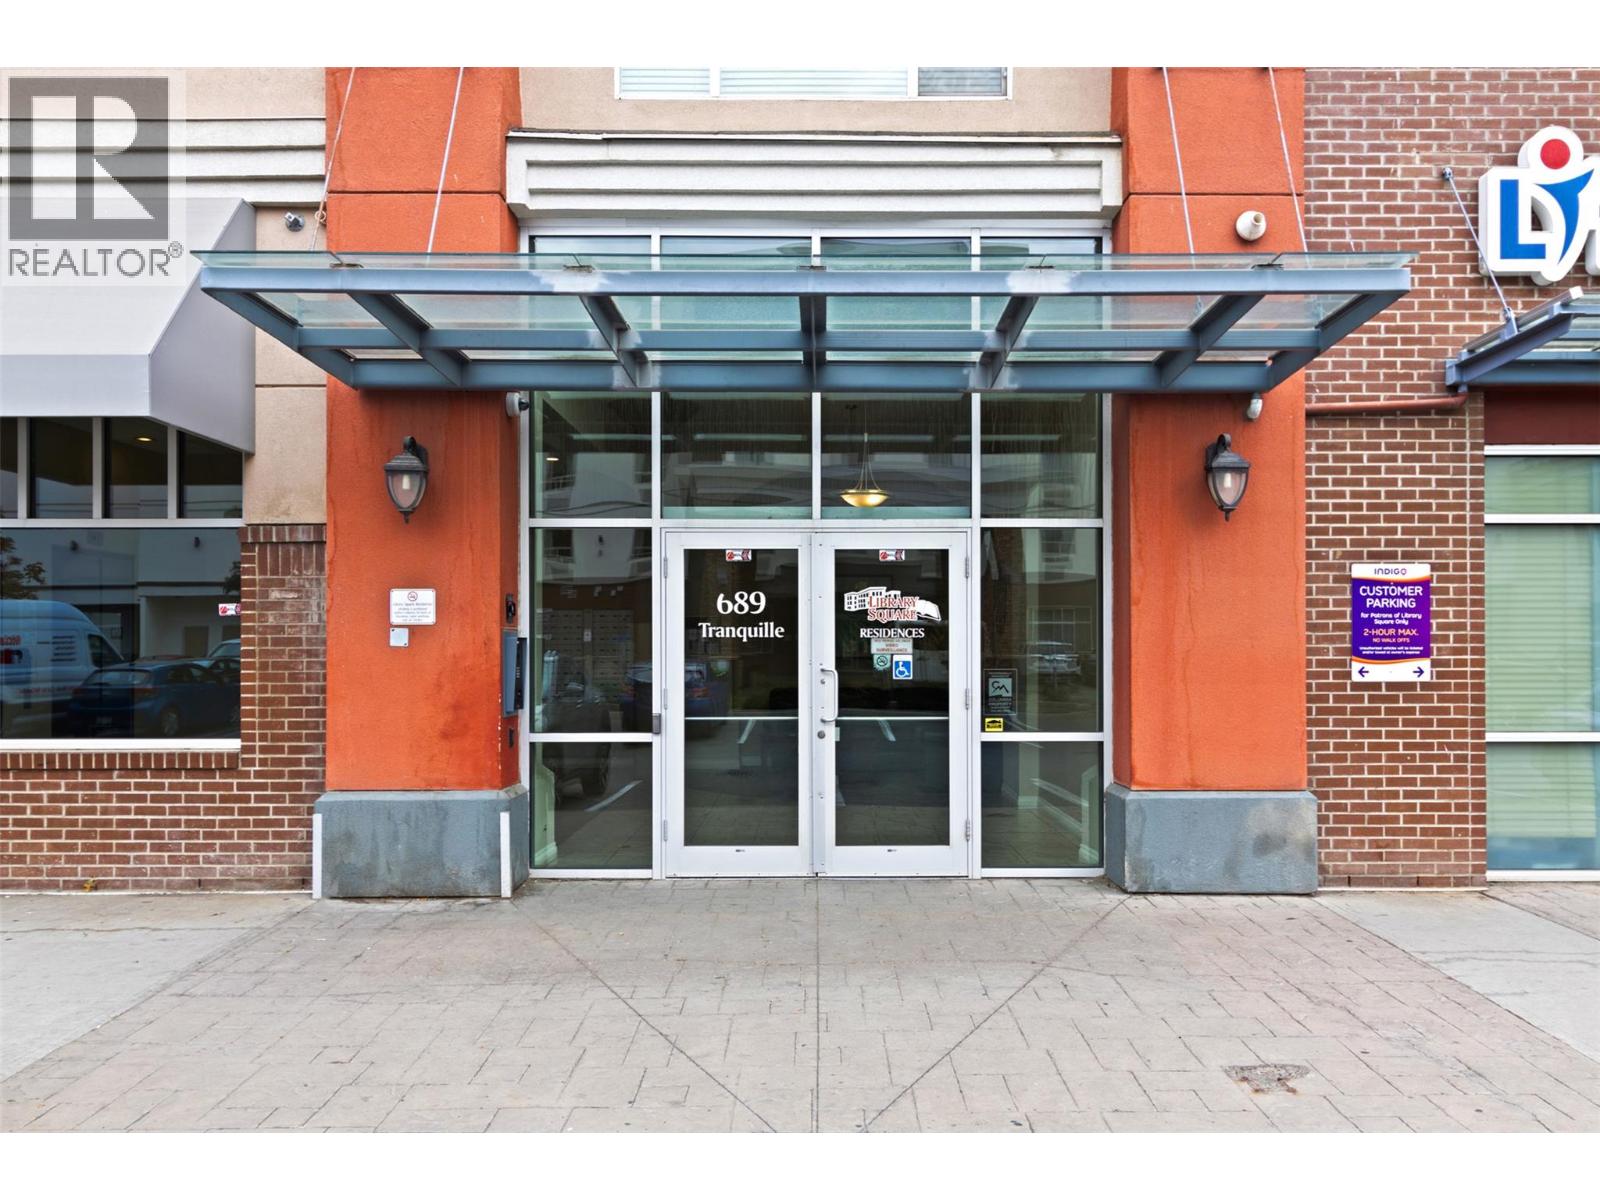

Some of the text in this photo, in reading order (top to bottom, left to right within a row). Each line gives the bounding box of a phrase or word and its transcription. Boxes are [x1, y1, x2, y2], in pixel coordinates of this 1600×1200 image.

[1374, 568, 1407, 576] INDIGO
[1359, 586, 1423, 596] CUSTOMER
[716, 591, 767, 615] 689
[868, 596, 918, 608] LIBRARY
[1366, 598, 1416, 608] PARKING
[868, 608, 917, 623] SQUARE
[698, 621, 785, 642] Tranquille
[860, 628, 925, 638] RESIDENCES
[1363, 628, 1419, 636] 2-HOUR MAX.
